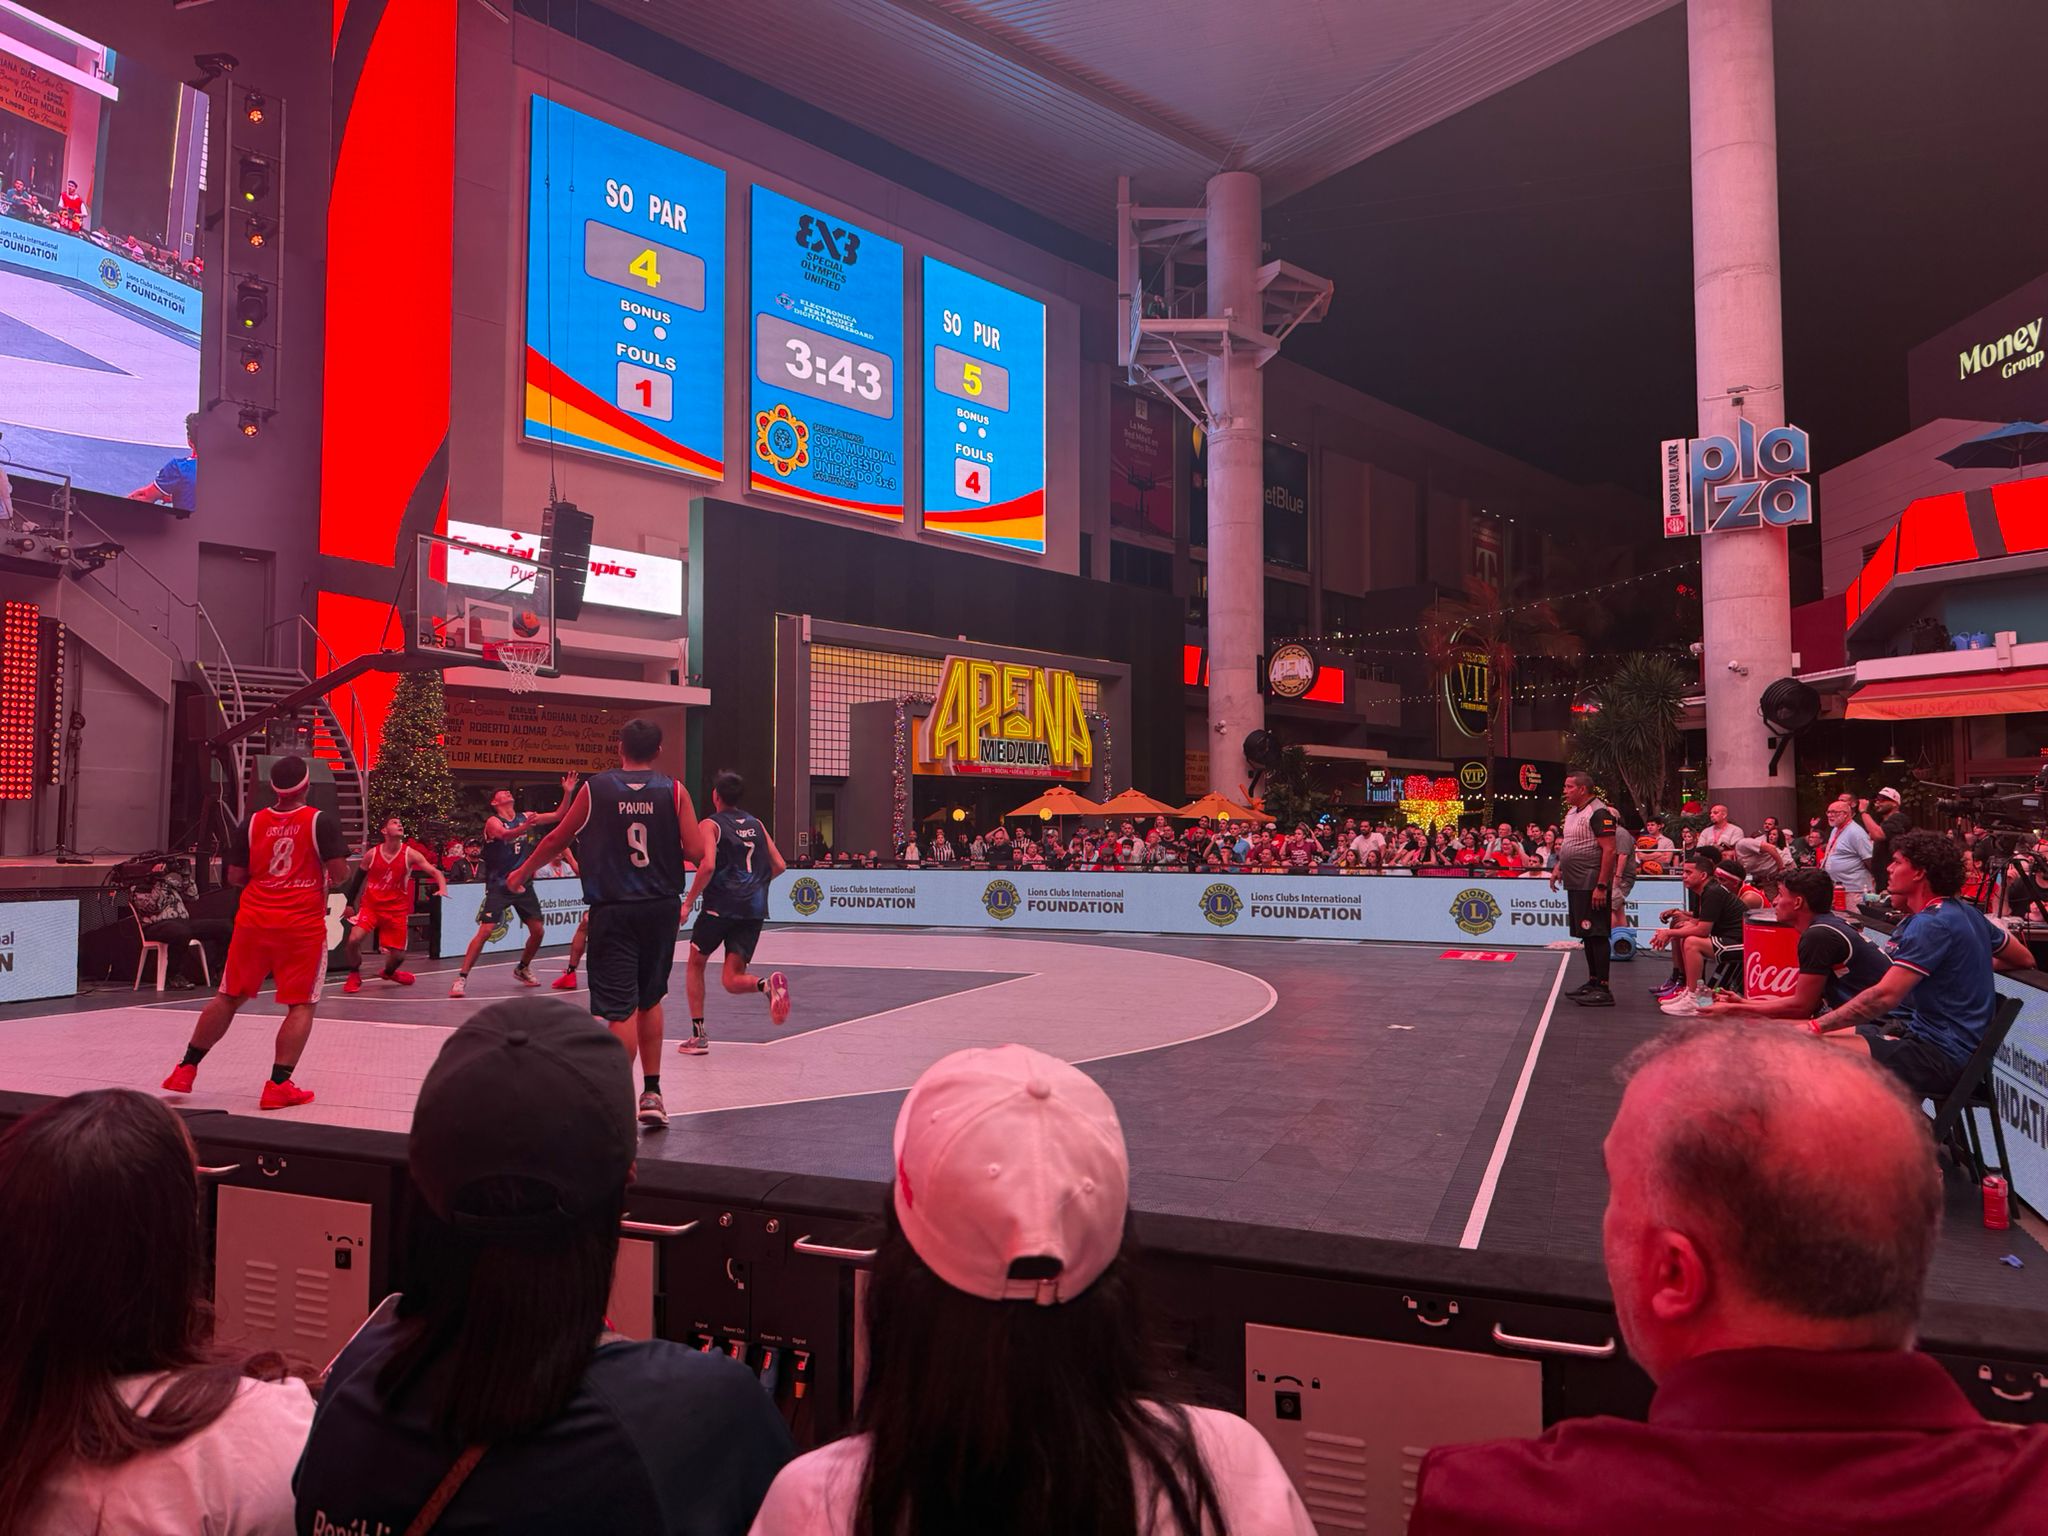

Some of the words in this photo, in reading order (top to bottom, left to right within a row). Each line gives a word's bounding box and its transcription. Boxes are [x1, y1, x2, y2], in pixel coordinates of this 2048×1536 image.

[605, 178, 634, 213] SO
[648, 195, 688, 234] PAR
[629, 249, 661, 288] 4
[801, 260, 847, 283] OLYMPICS
[806, 252, 844, 272] SPECIAL
[804, 272, 841, 291] UNIFIED
[125, 281, 186, 315] FOUNDATION
[620, 300, 672, 324] BONUS
[826, 318, 874, 340] SCOREBOARD
[943, 309, 962, 337] SO
[973, 321, 1001, 351] PUR
[616, 343, 677, 372] FOULS
[1959, 317, 2044, 380] Money
[785, 338, 882, 401] 3:43
[2002, 349, 2046, 380] Group
[962, 362, 983, 396] 5
[635, 379, 653, 408] 1
[956, 408, 990, 425] BONUS
[814, 433, 843, 451] COPA
[847, 442, 896, 465] MUNDIAL
[814, 446, 883, 474] BALONCESTO
[955, 443, 994, 463] FOULS
[814, 459, 873, 485] UNIFICADO
[965, 471, 981, 493] 4
[1669, 443, 1680, 516] POPULAR
[1264, 486, 1304, 514] etBlue
[541, 711, 578, 723] ADRIANA
[934, 658, 1093, 767] ARENA
[470, 721, 510, 734] ROBERTO
[512, 724, 548, 737] ALOMAR
[980, 738, 1050, 766] MEDALLA
[1464, 771, 1484, 783] VIP
[269, 837, 294, 877] 8
[627, 821, 650, 868] 9
[743, 841, 755, 873] 7
[830, 884, 847, 893] Lions
[849, 884, 867, 894] Clubs
[869, 885, 916, 895] International
[830, 896, 916, 909] FOUNDATION
[1027, 888, 1046, 897] Lions
[1048, 888, 1068, 897] Clubs
[1071, 889, 1124, 899] International
[1208, 885, 1234, 895] LIONS
[1250, 892, 1272, 902] Lions
[1274, 892, 1298, 903] Clubs
[1301, 893, 1362, 905] International
[1461, 891, 1491, 903] LIONS
[1027, 900, 1124, 914] FOUNDATION
[1250, 905, 1362, 921] FOUNDATION
[1510, 898, 1536, 908] Lions
[1539, 898, 1567, 909] Clubs
[1744, 952, 1798, 994] Coca
